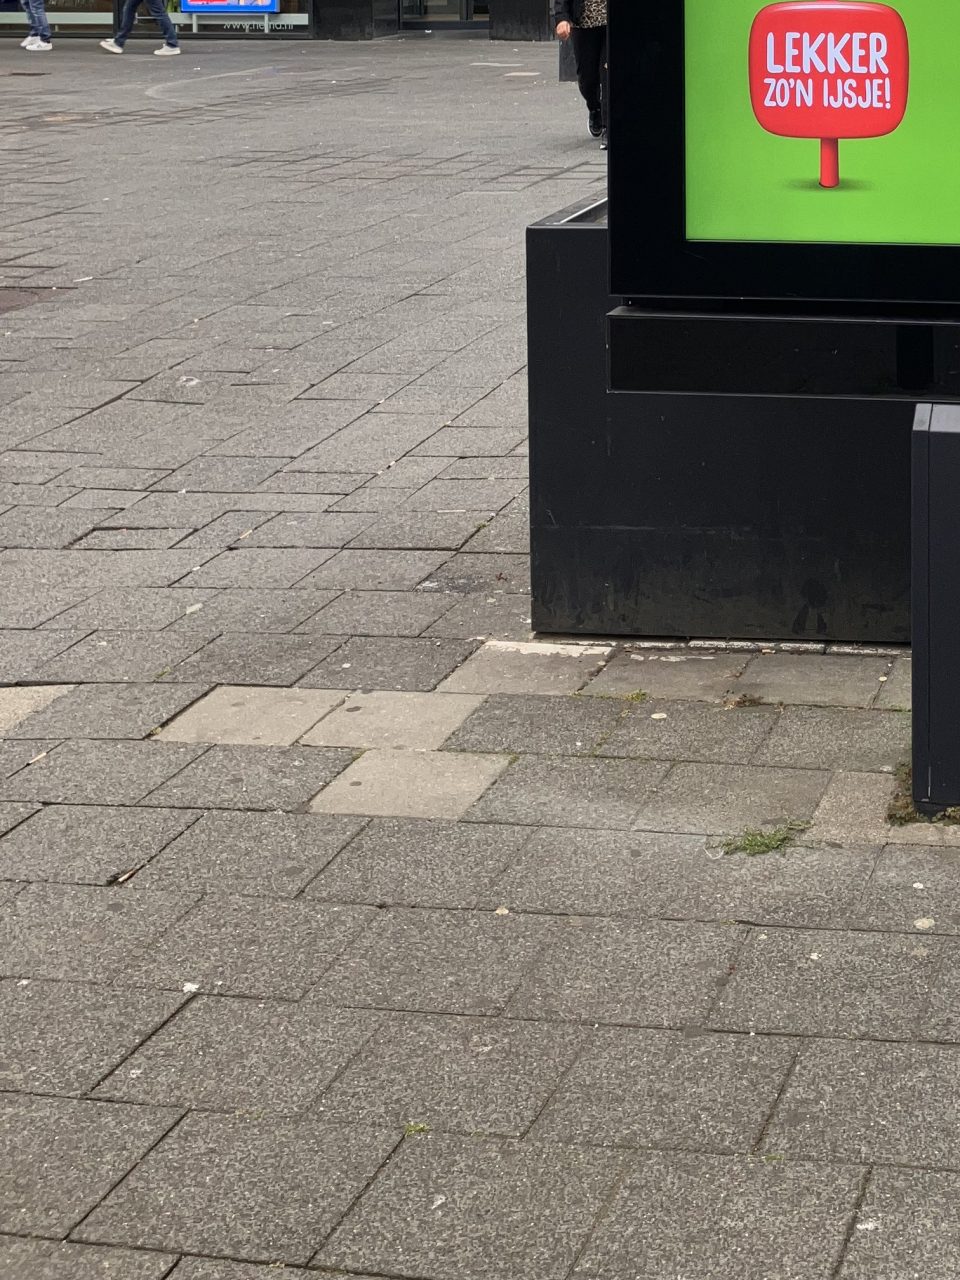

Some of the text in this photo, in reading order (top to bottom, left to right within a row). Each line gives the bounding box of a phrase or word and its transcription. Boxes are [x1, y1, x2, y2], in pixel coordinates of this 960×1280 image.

[766, 31, 889, 75] LEKKER
[763, 77, 892, 110] ZO'N IJSJE!
